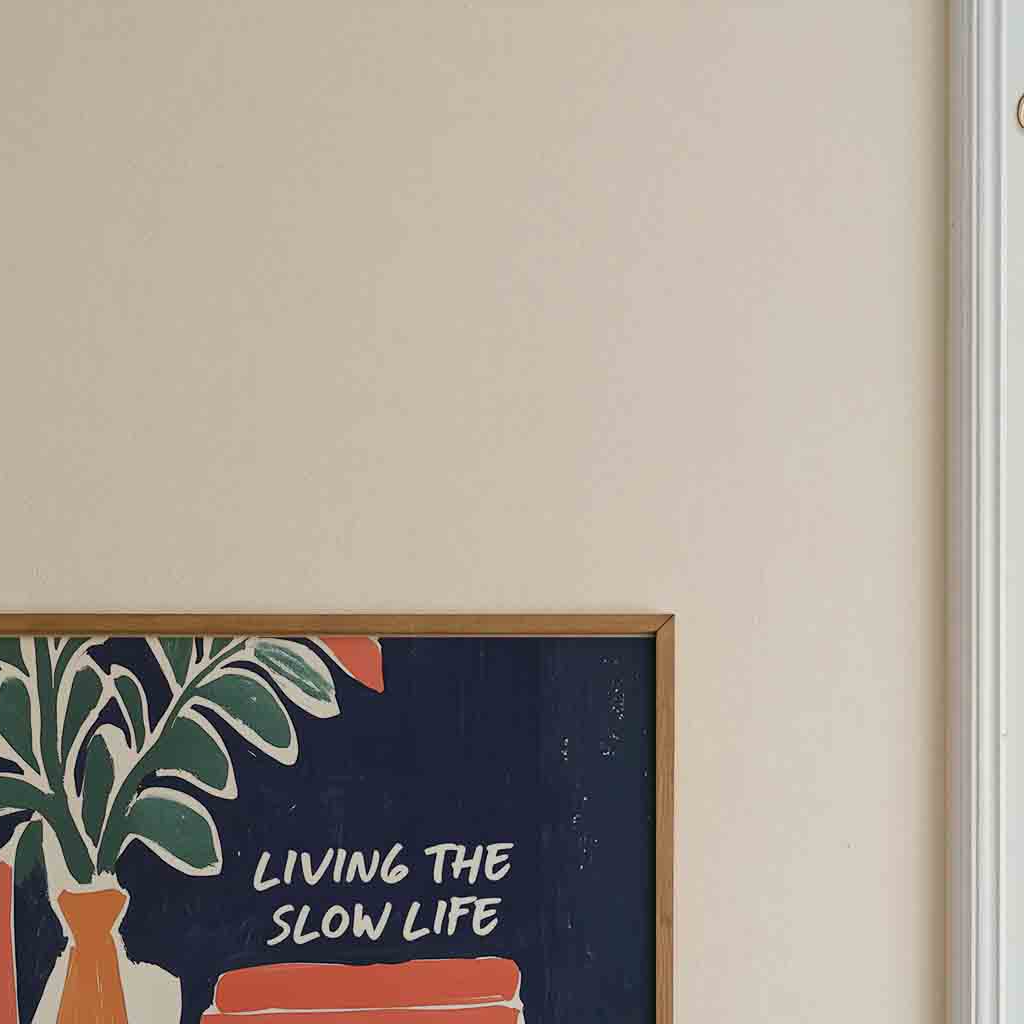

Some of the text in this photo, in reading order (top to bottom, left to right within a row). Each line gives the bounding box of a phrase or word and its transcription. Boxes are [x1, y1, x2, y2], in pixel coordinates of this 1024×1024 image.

[253, 842, 515, 892] LIVING THE
[266, 895, 502, 946] SLOW LIFE
